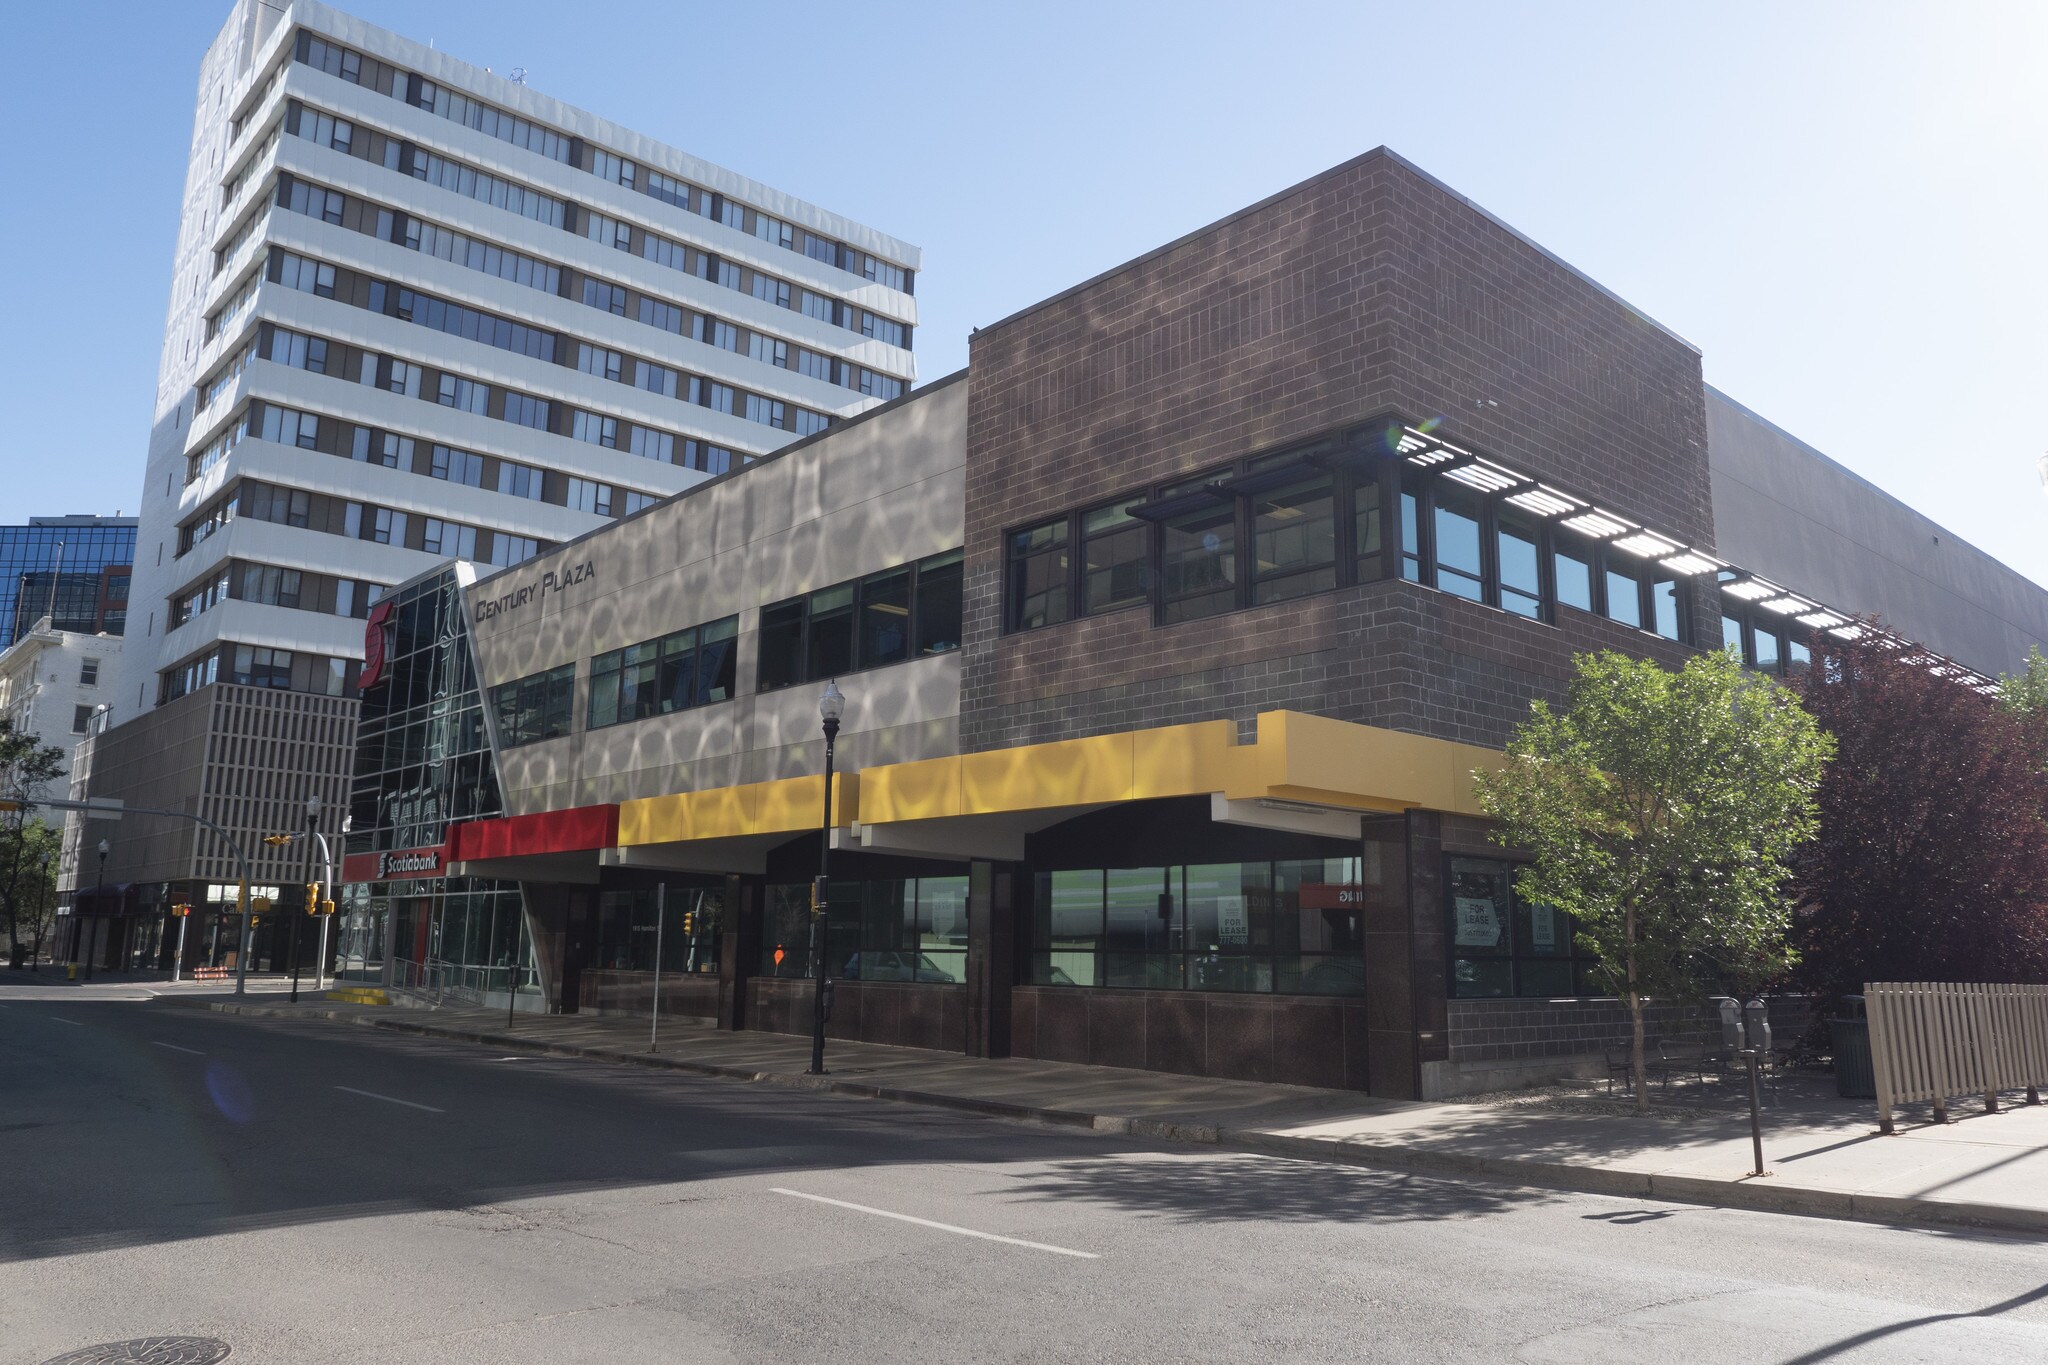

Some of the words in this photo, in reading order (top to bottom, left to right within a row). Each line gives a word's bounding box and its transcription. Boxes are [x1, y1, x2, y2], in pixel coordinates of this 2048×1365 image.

[387, 851, 437, 873] Scotiabank
[1469, 903, 1485, 914] FOR
[1224, 918, 1241, 926] FOR
[1464, 914, 1489, 925] LEASE
[1220, 926, 1247, 935] LEASE
